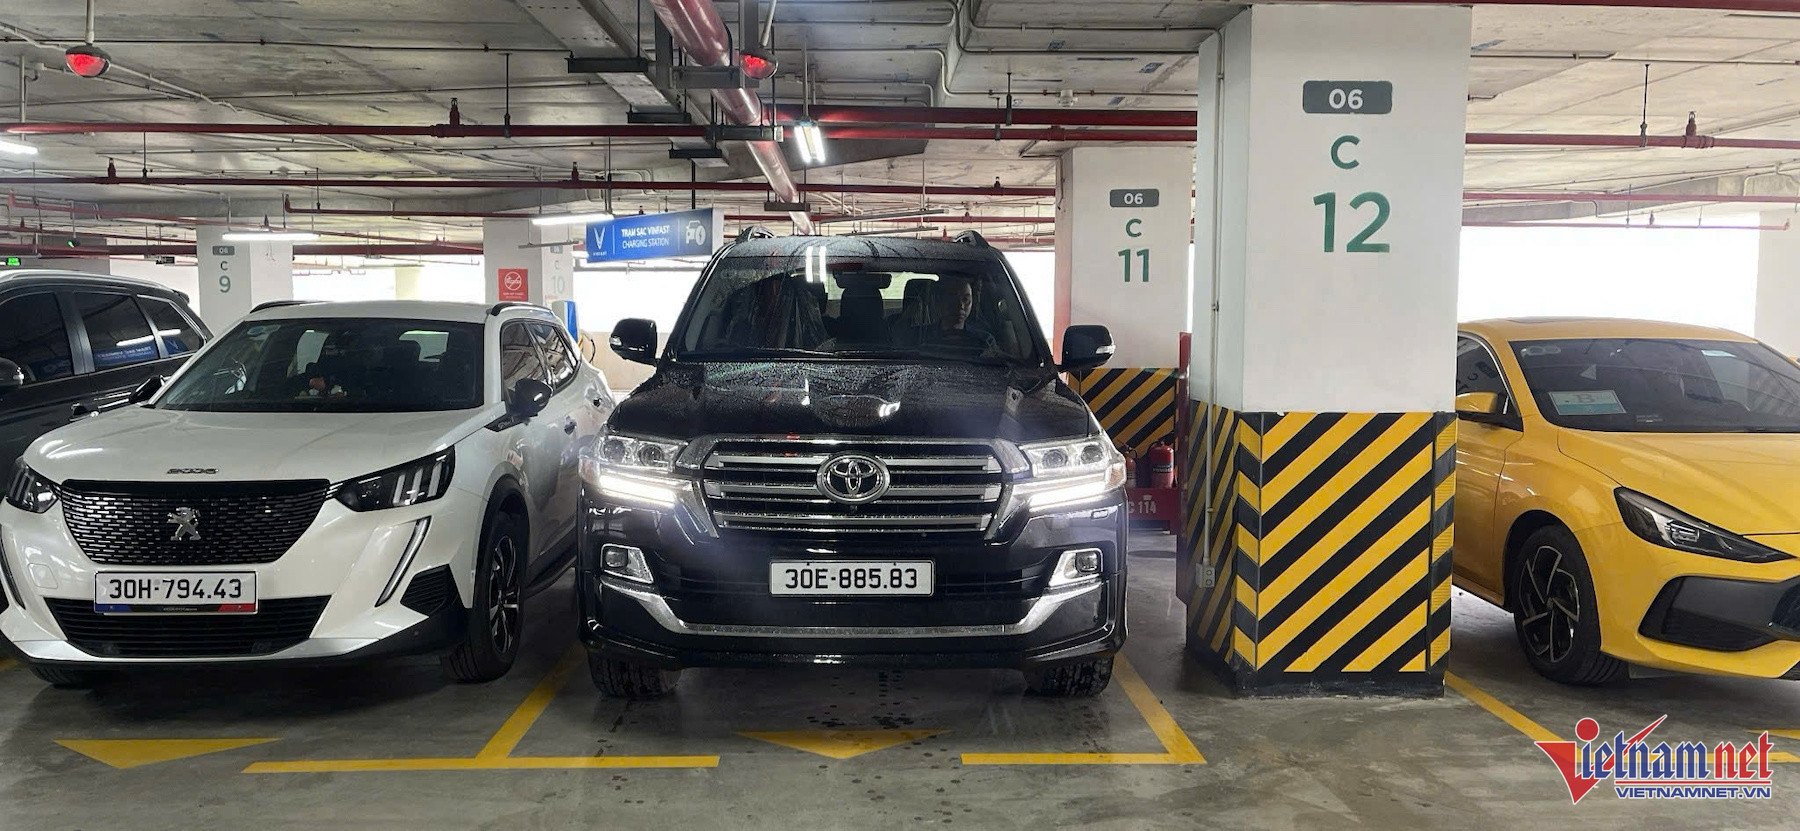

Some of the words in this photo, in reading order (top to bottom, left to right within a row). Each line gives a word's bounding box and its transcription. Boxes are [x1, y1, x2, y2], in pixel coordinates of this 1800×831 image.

[1328, 88, 1364, 110] 06
[1330, 134, 1361, 170] C
[1123, 192, 1144, 205] 06
[648, 225, 670, 235] VINFAST
[1125, 218, 1142, 238] C
[1312, 191, 1391, 253] 12
[622, 239, 648, 249] CHARGING
[648, 237, 670, 247] STATION
[220, 260, 228, 271] C
[1117, 248, 1150, 283] 11
[219, 275, 231, 293] 9
[551, 275, 566, 294] 10
[1138, 501, 1157, 514] 114
[784, 567, 917, 590] 30E-885.83
[109, 578, 242, 599] 30H-794.43
